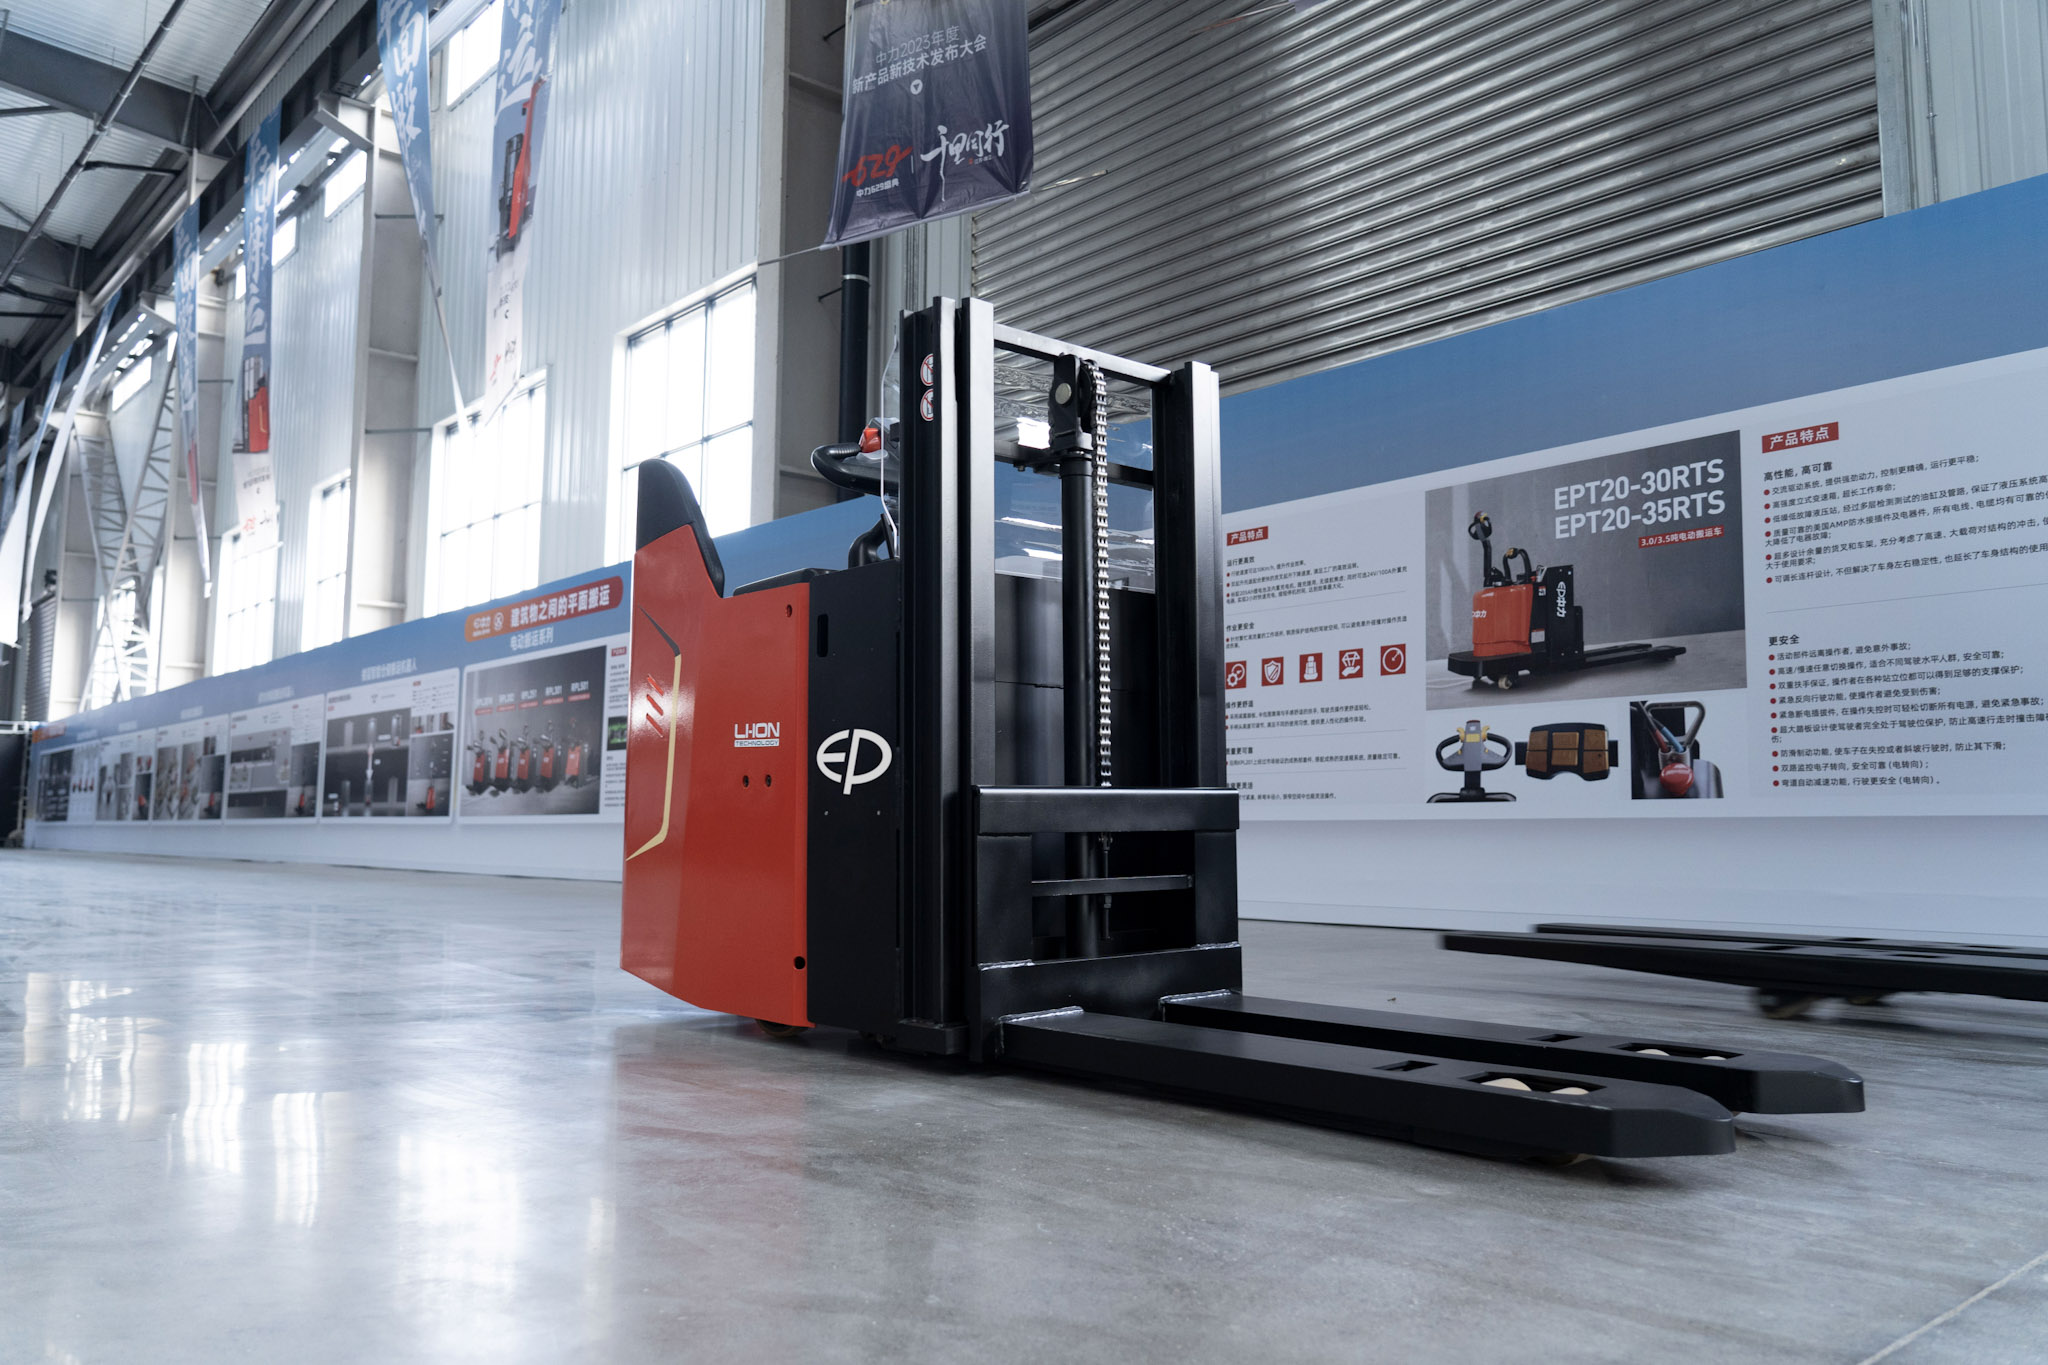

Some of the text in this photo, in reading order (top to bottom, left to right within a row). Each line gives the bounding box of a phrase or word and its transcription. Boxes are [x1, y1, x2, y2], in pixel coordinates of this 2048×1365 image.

[852, 33, 987, 95] 新产品新技术发布大会
[875, 25, 960, 66] 中力2023年度
[841, 144, 913, 187] 629
[1769, 426, 1830, 450] 产品特点
[1554, 458, 1725, 511] EPT20-30RTS
[1555, 489, 1726, 539] EPT20-35RTS
[1231, 529, 1264, 544] 产品特点
[1641, 527, 1722, 547] 3.0/3.5吨电动搬运车
[511, 584, 610, 628] 建筑物之间的平面搬运
[1768, 634, 1800, 647] 更安全
[816, 728, 893, 796] EP
